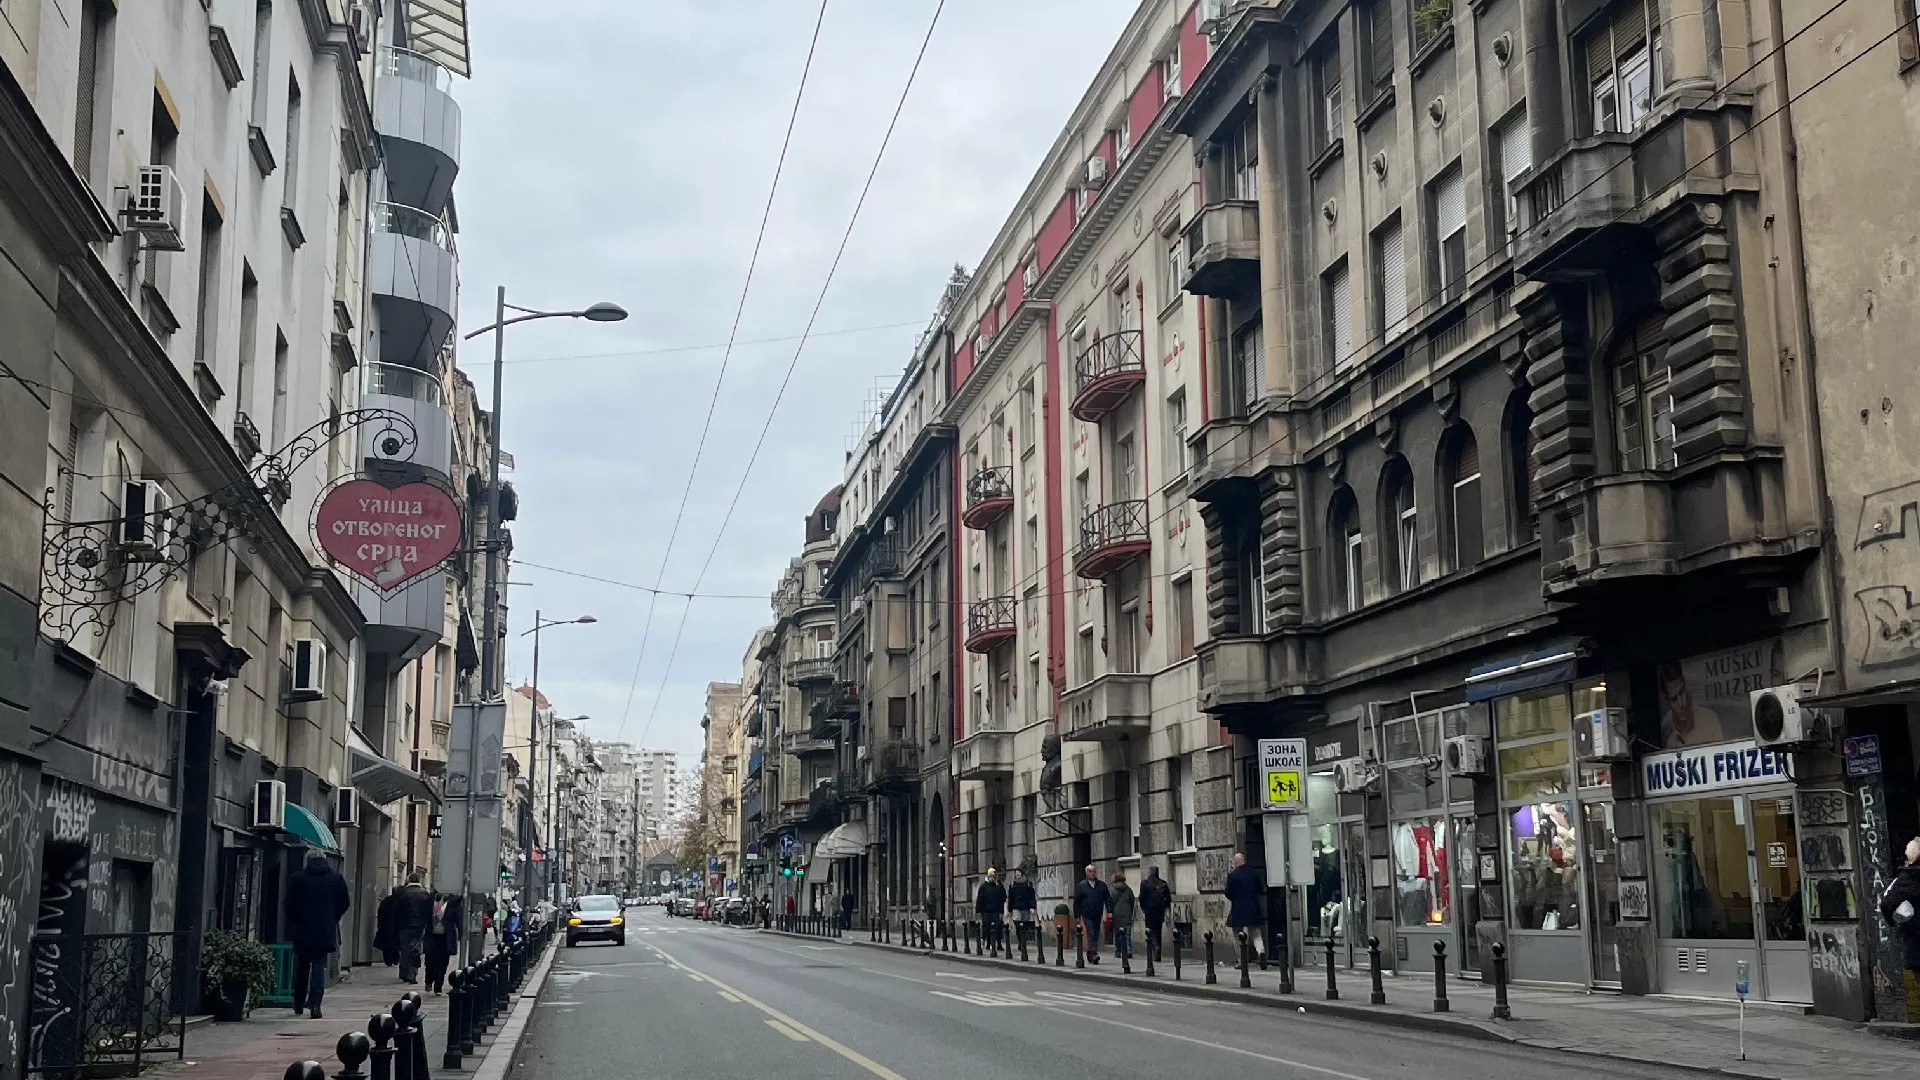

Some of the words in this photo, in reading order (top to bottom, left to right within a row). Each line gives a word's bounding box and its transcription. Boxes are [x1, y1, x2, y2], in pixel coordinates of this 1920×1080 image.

[359, 498, 423, 516] УЛИЦА
[332, 520, 447, 540] ОТВОРЕНОГ
[1705, 649, 1760, 679] MUŠKI
[1705, 674, 1763, 701] FRIZER
[1267, 745, 1297, 755] ЗОНА
[1264, 757, 1302, 767] ШКОЛЕ
[1646, 751, 1708, 791] MUŠKI
